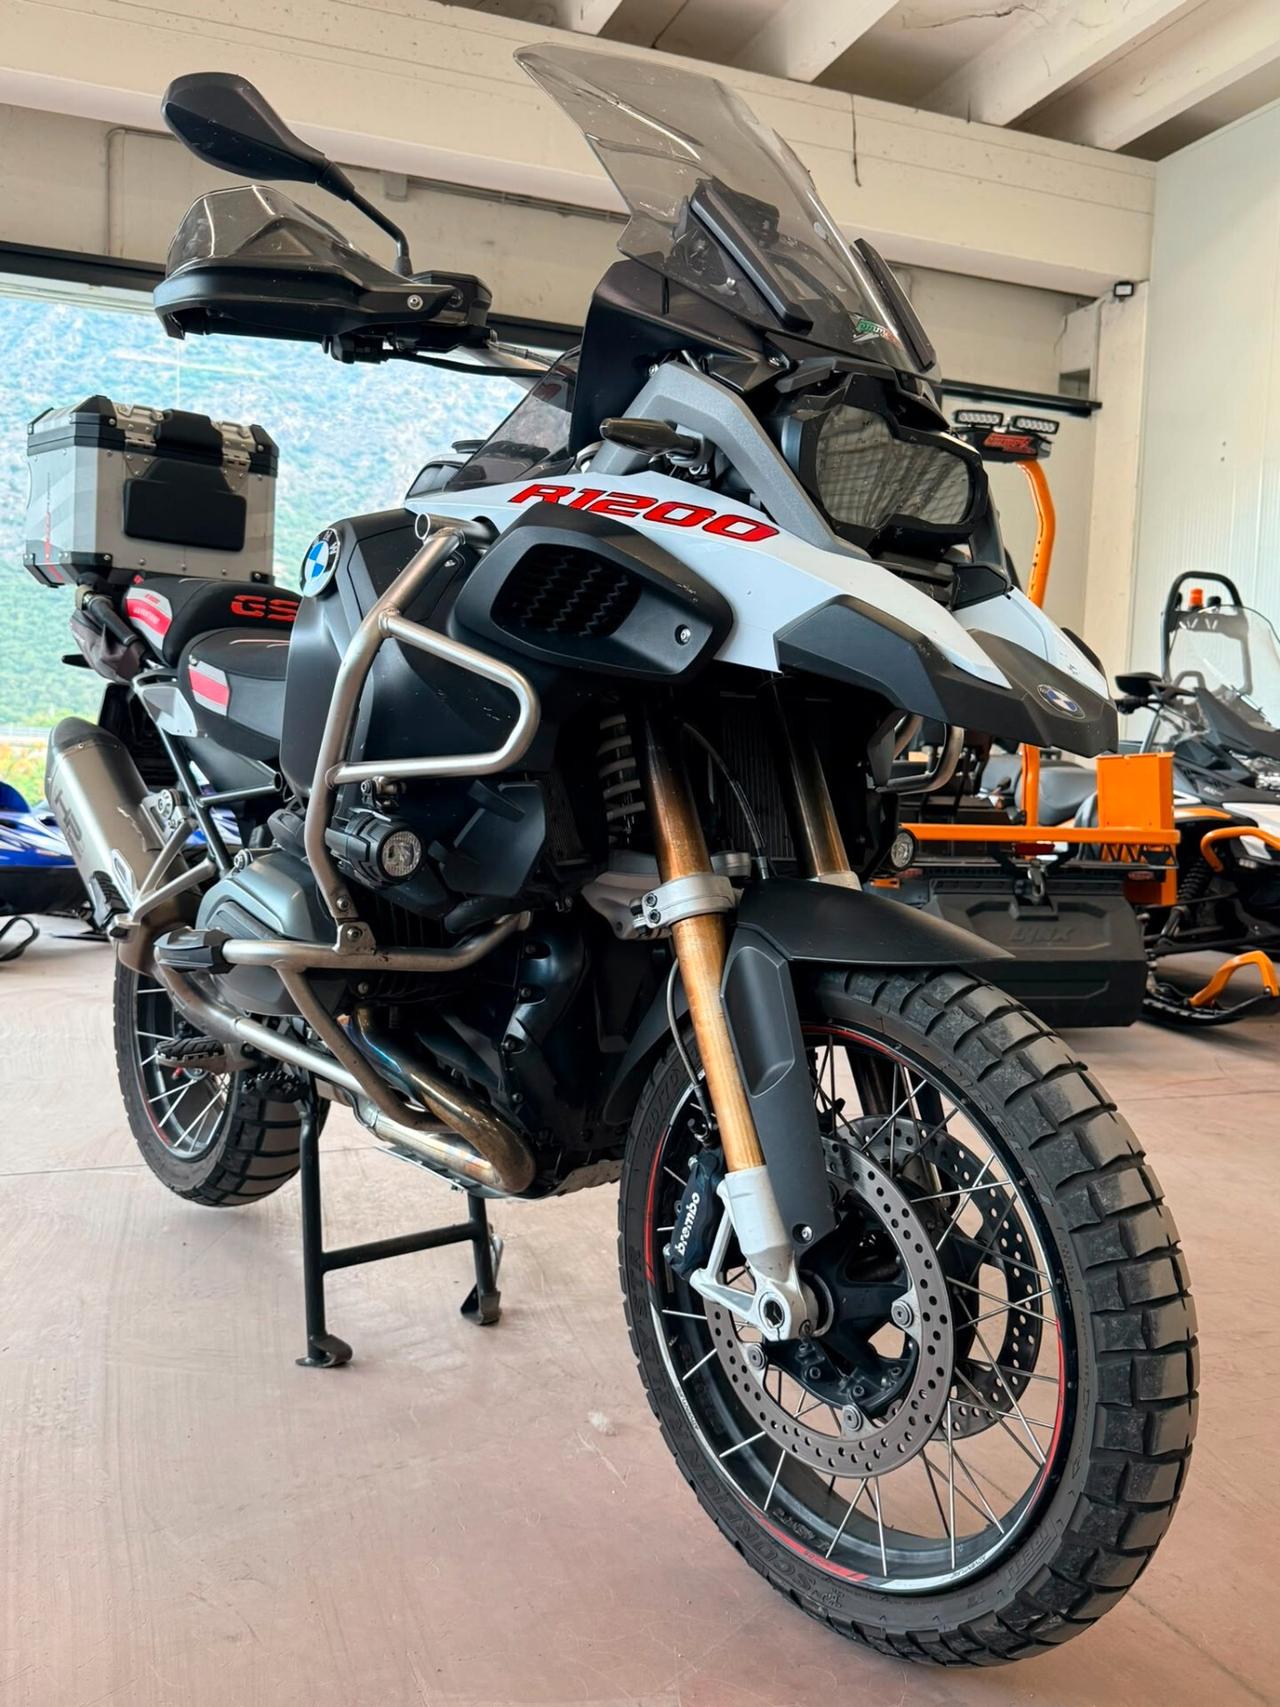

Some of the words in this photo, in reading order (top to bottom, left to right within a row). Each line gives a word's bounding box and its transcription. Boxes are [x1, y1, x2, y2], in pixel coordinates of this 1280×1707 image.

[508, 483, 780, 543] R1200
[229, 594, 299, 621] GS
[940, 1059, 1055, 1208] PIRELLI
[674, 1192, 700, 1256] brembo
[686, 1446, 818, 1591] SCORPION
